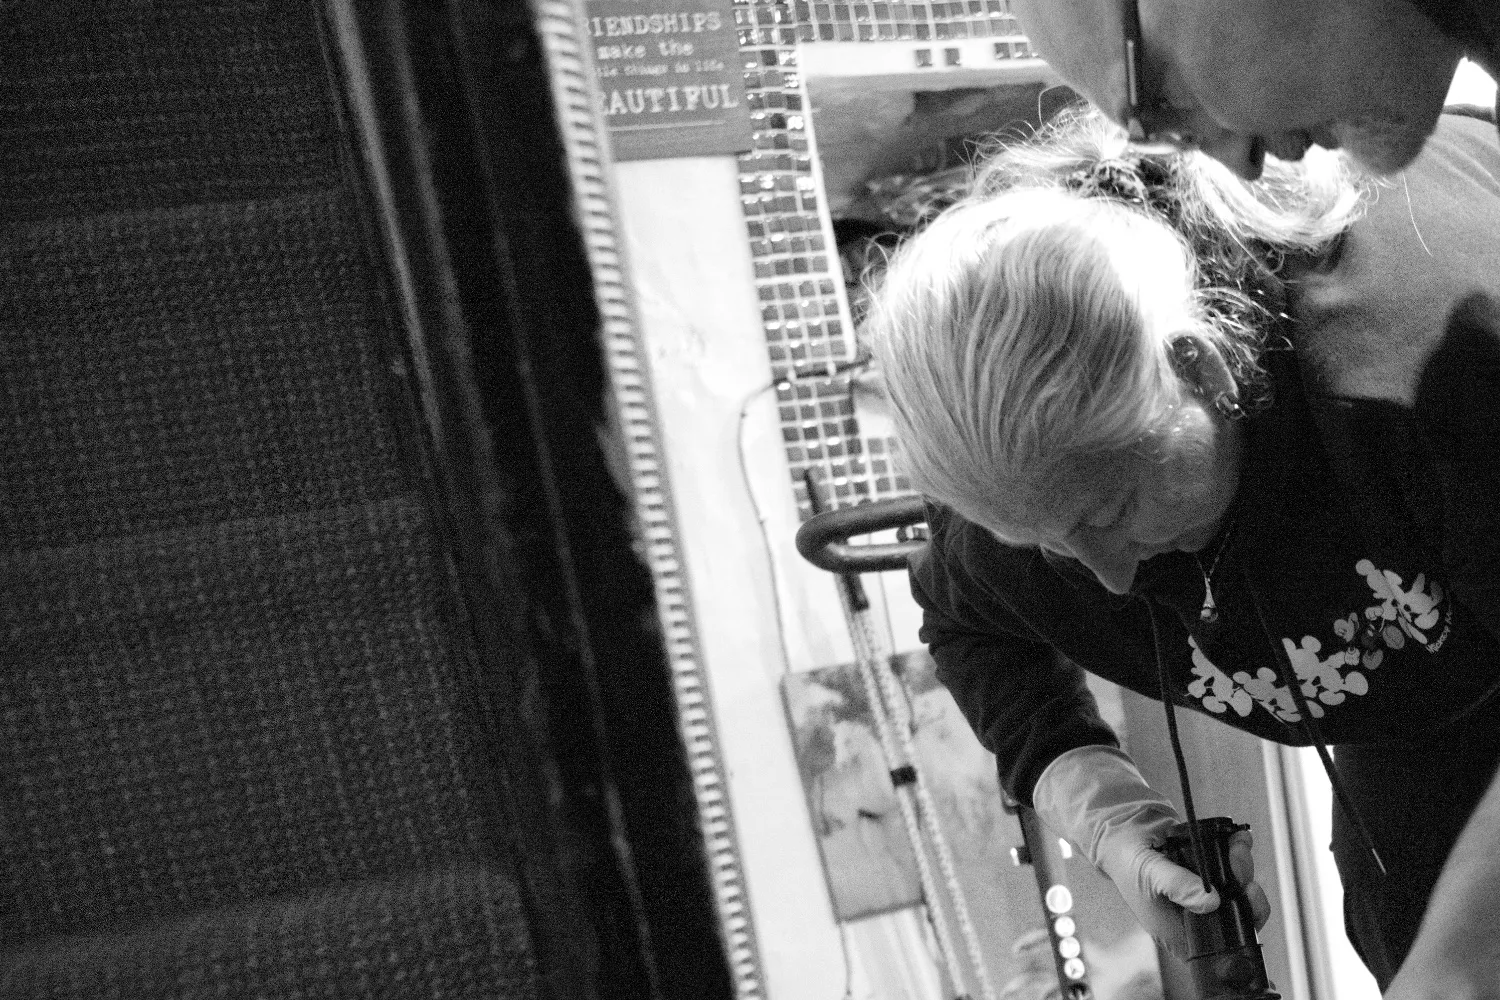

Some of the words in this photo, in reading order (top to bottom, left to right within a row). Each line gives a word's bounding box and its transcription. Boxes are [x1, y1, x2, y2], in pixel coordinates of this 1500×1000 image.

[590, 11, 722, 36] IENDSHIPS
[598, 44, 646, 59] make
[658, 39, 695, 56] the
